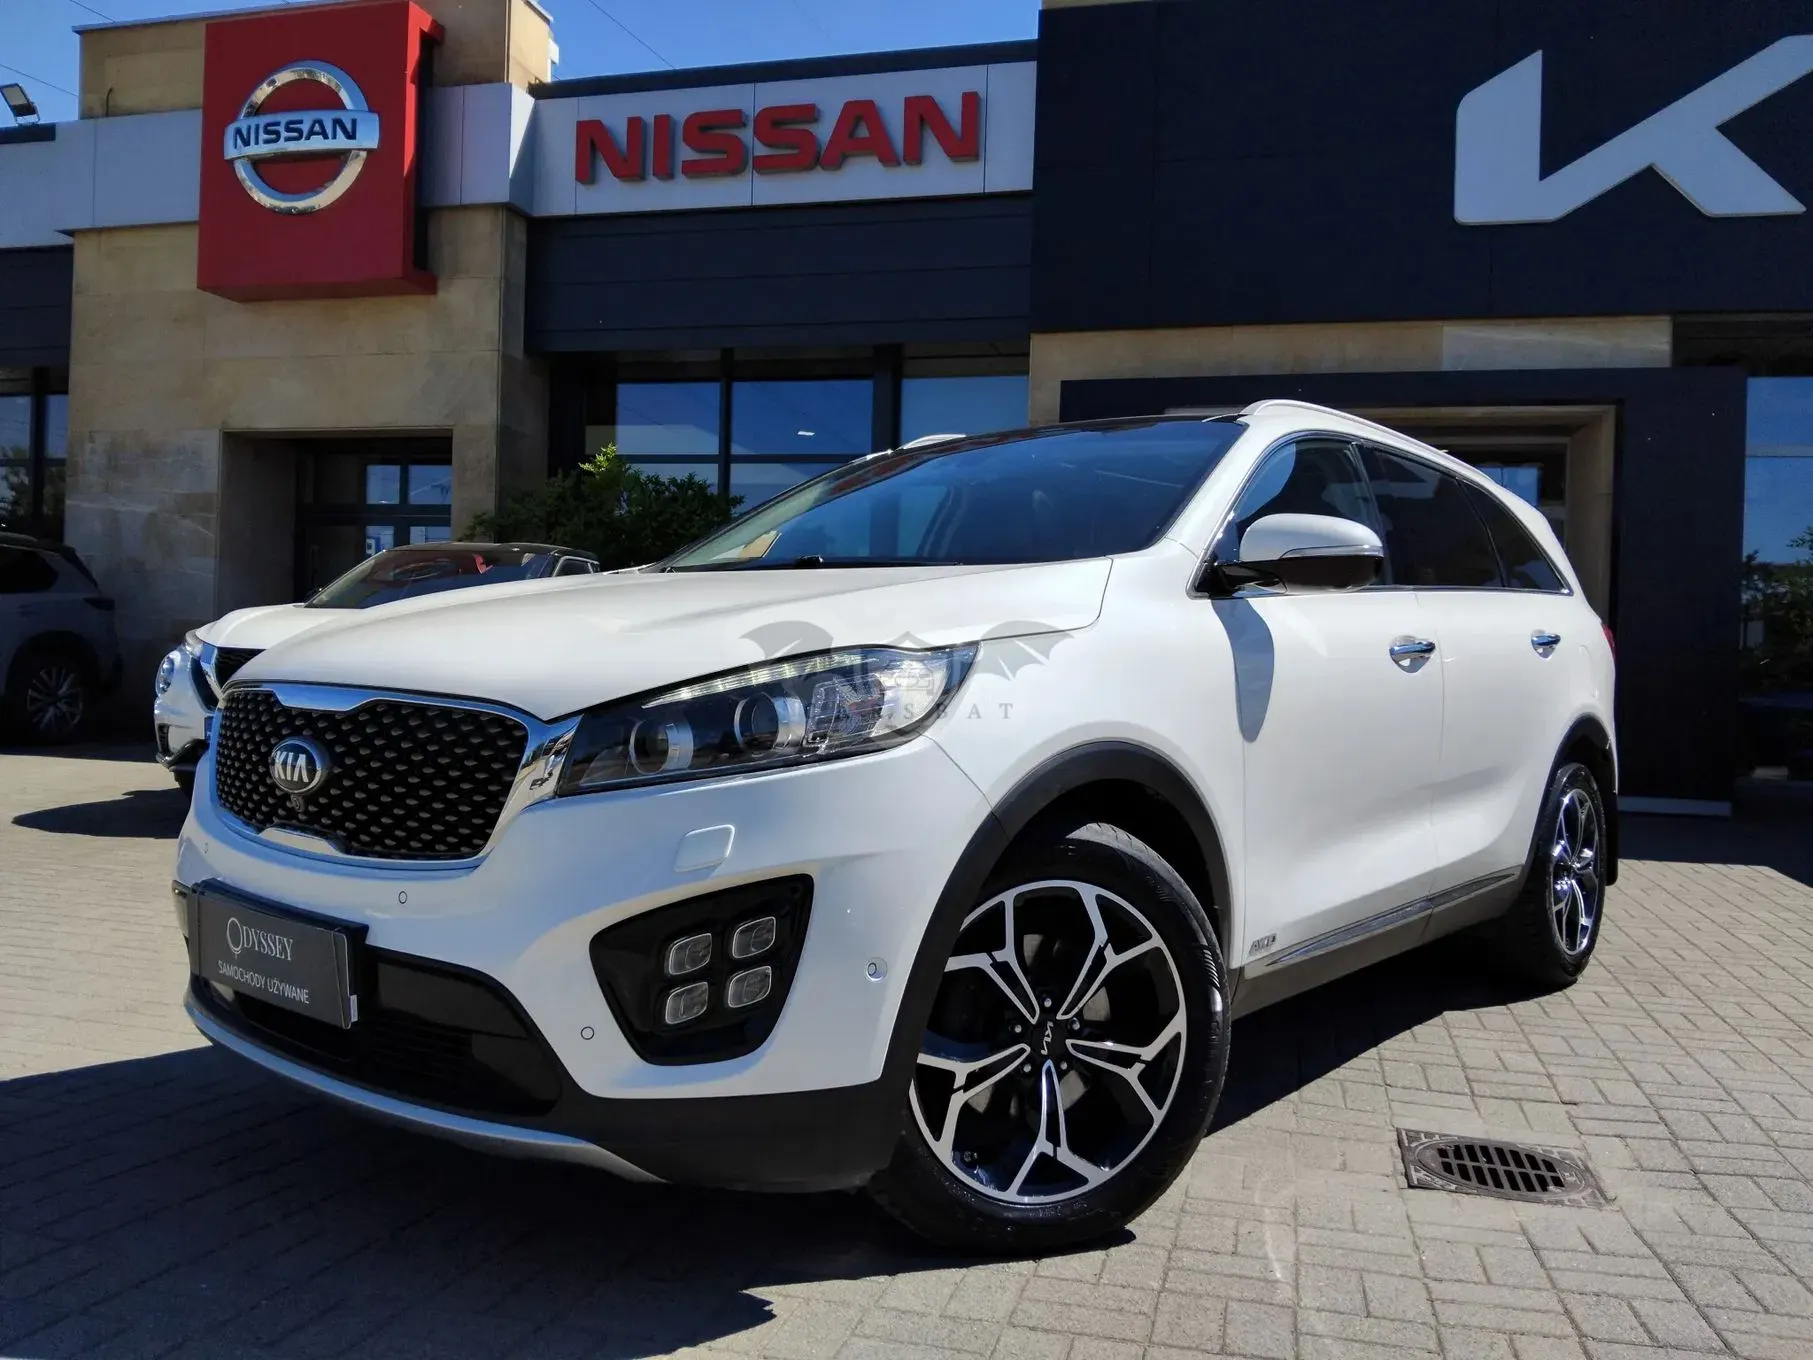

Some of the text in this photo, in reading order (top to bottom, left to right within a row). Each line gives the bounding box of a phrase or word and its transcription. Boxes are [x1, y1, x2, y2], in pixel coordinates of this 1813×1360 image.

[233, 117, 358, 149] NISSAN
[575, 91, 980, 184] NISSAN
[274, 750, 309, 782] KIA
[226, 917, 293, 961] ODYSSEY
[218, 960, 310, 1004] SAMOCHODY UŻYWANE
